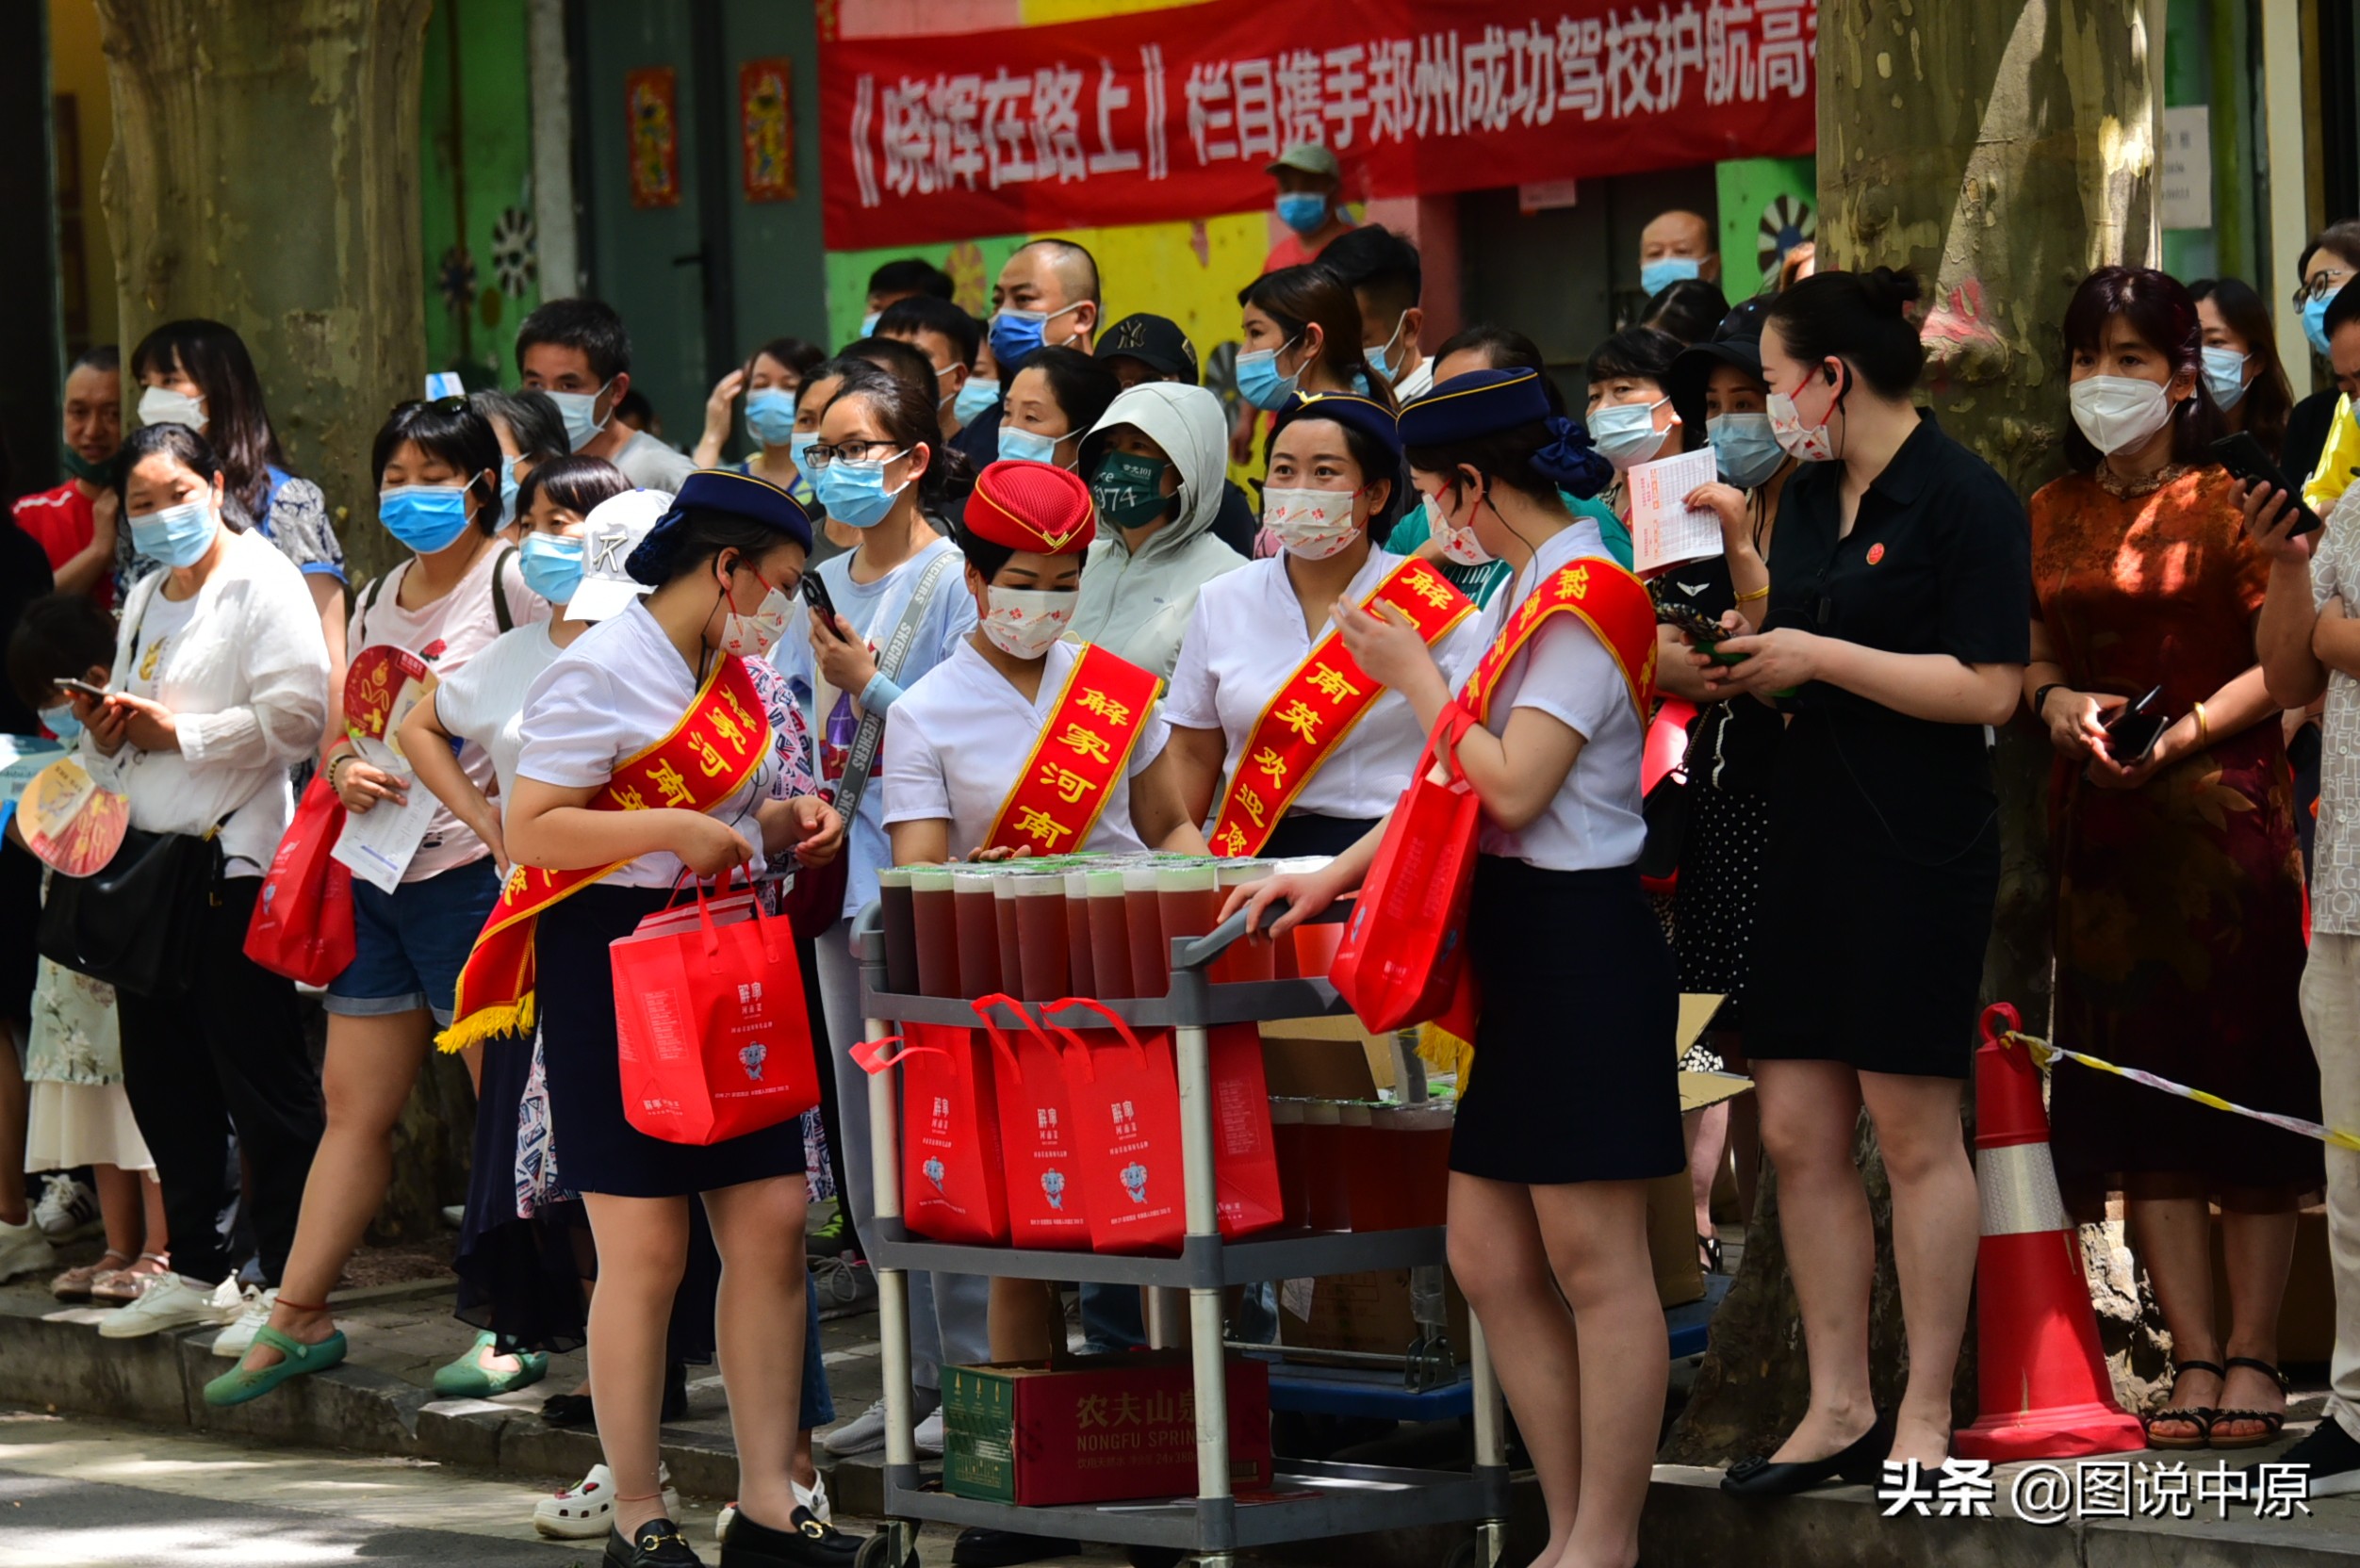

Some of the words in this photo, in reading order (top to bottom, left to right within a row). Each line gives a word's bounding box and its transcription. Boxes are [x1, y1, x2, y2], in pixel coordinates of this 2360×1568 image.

[851, 0, 1816, 207] 《晓辉在路上》栏目携手郑州成功驾校护航高
[914, 553, 957, 605] SKECHERS
[852, 710, 880, 772] KECHERS
[1012, 687, 1130, 848] 解家河南
[1076, 1432, 1140, 1452] NONGFU
